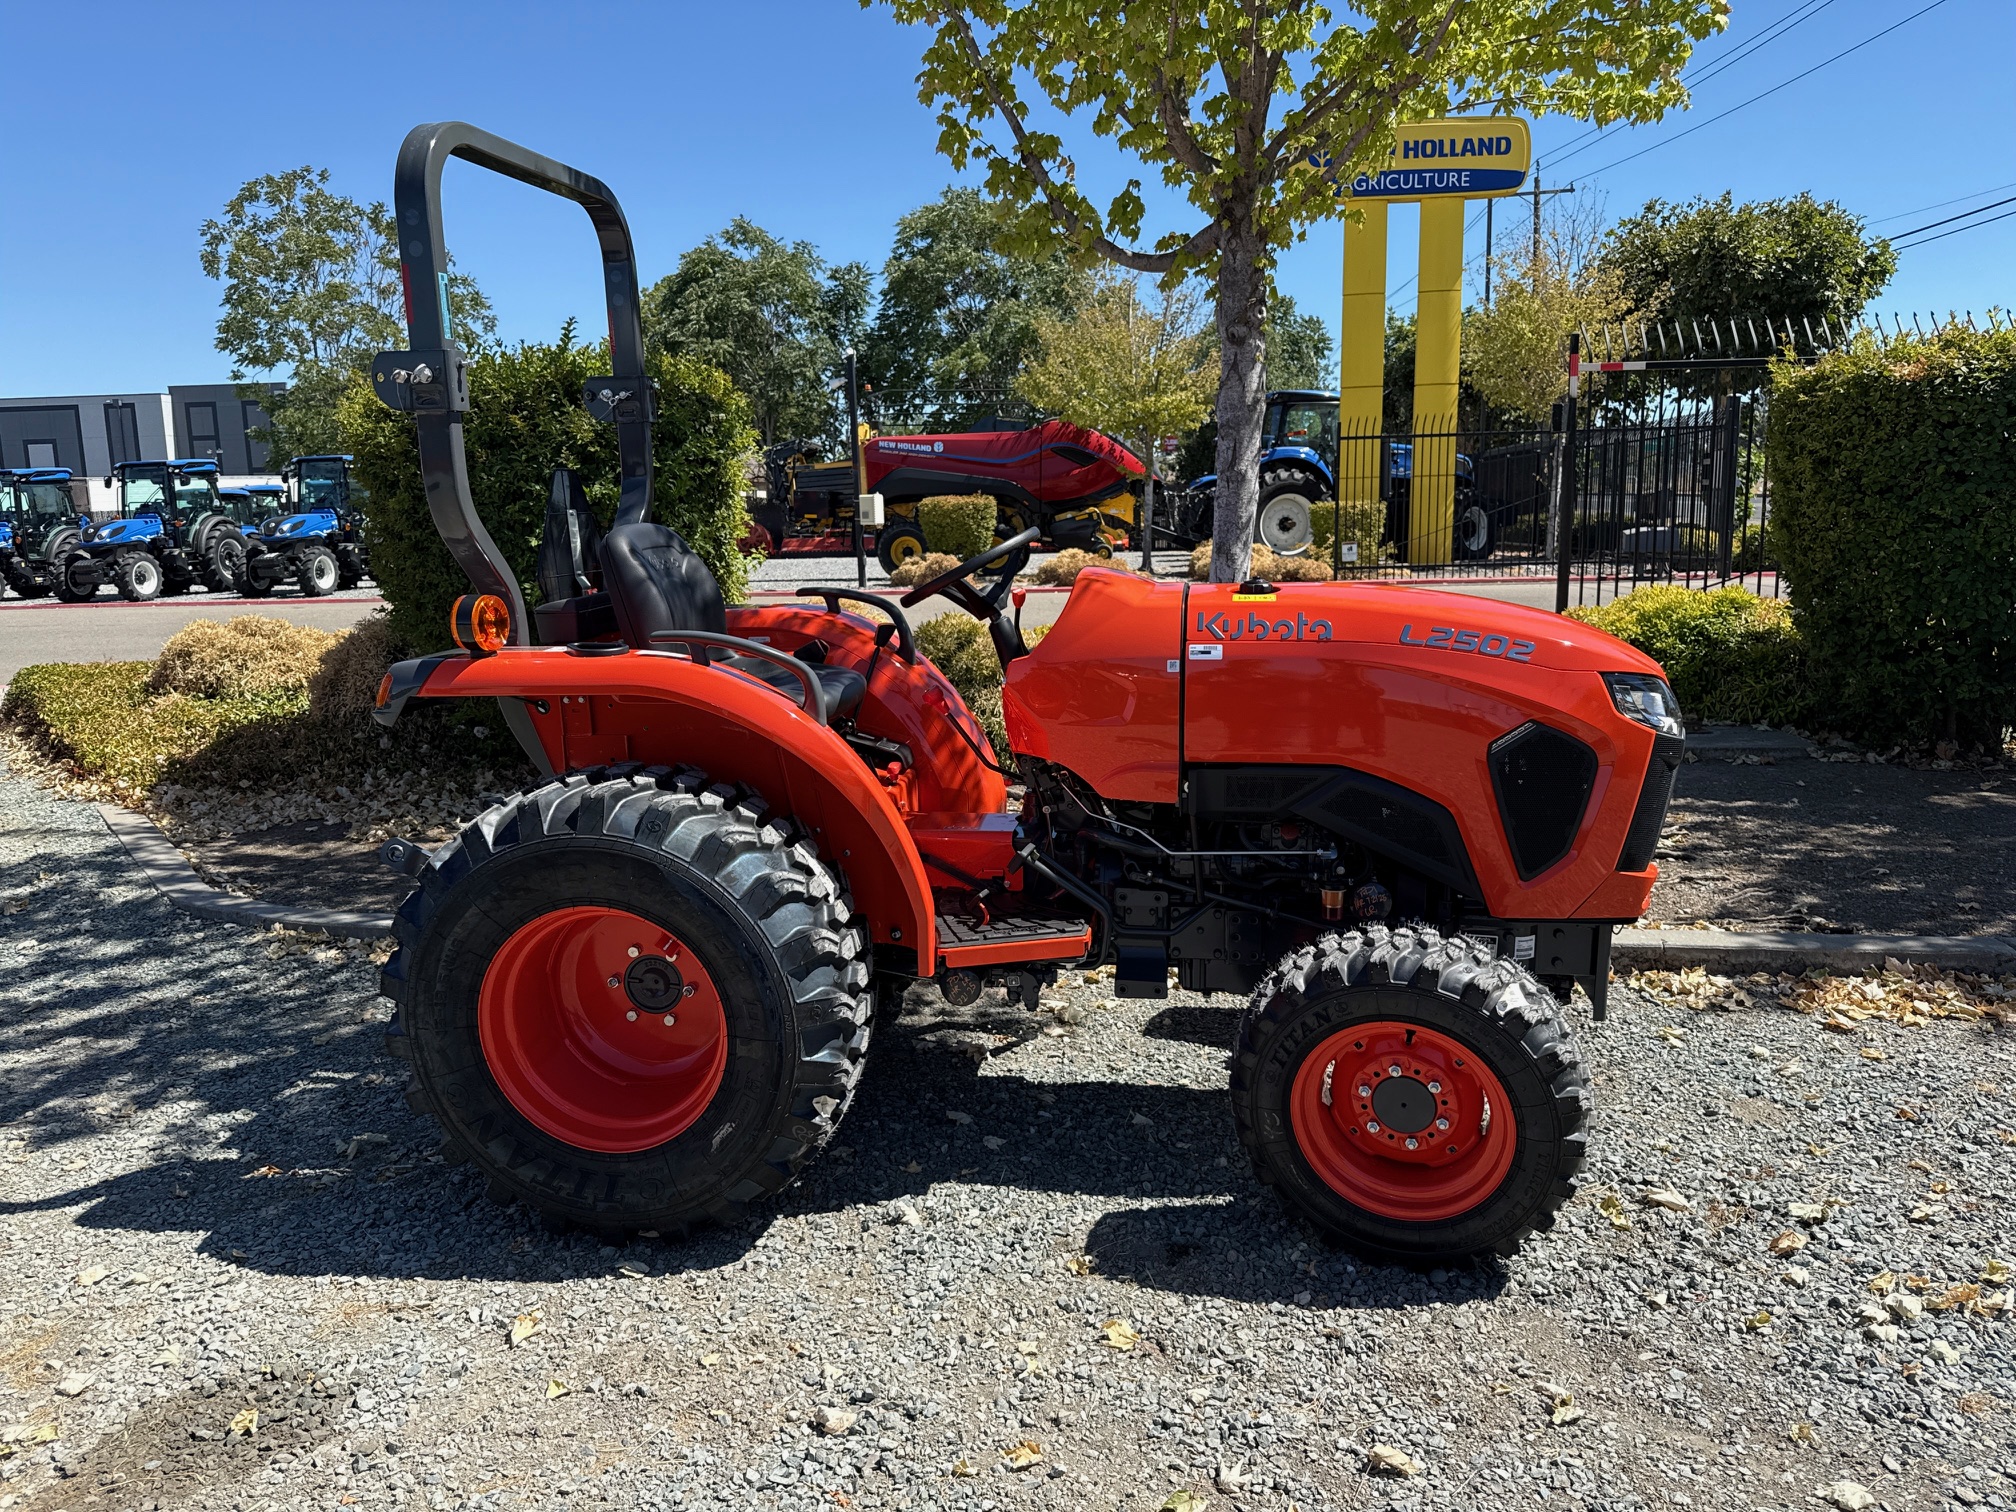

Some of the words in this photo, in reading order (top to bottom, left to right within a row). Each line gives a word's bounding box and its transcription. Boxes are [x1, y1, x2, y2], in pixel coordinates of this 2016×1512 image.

[1403, 136, 1512, 160] HOLLAND
[879, 441, 896, 449] NEW
[897, 442, 932, 452] HOLLAND
[1196, 611, 1333, 640] Kubota
[1399, 623, 1537, 663] L2502
[1270, 1005, 1333, 1069] TITAN
[461, 1111, 627, 1205] TITAN
